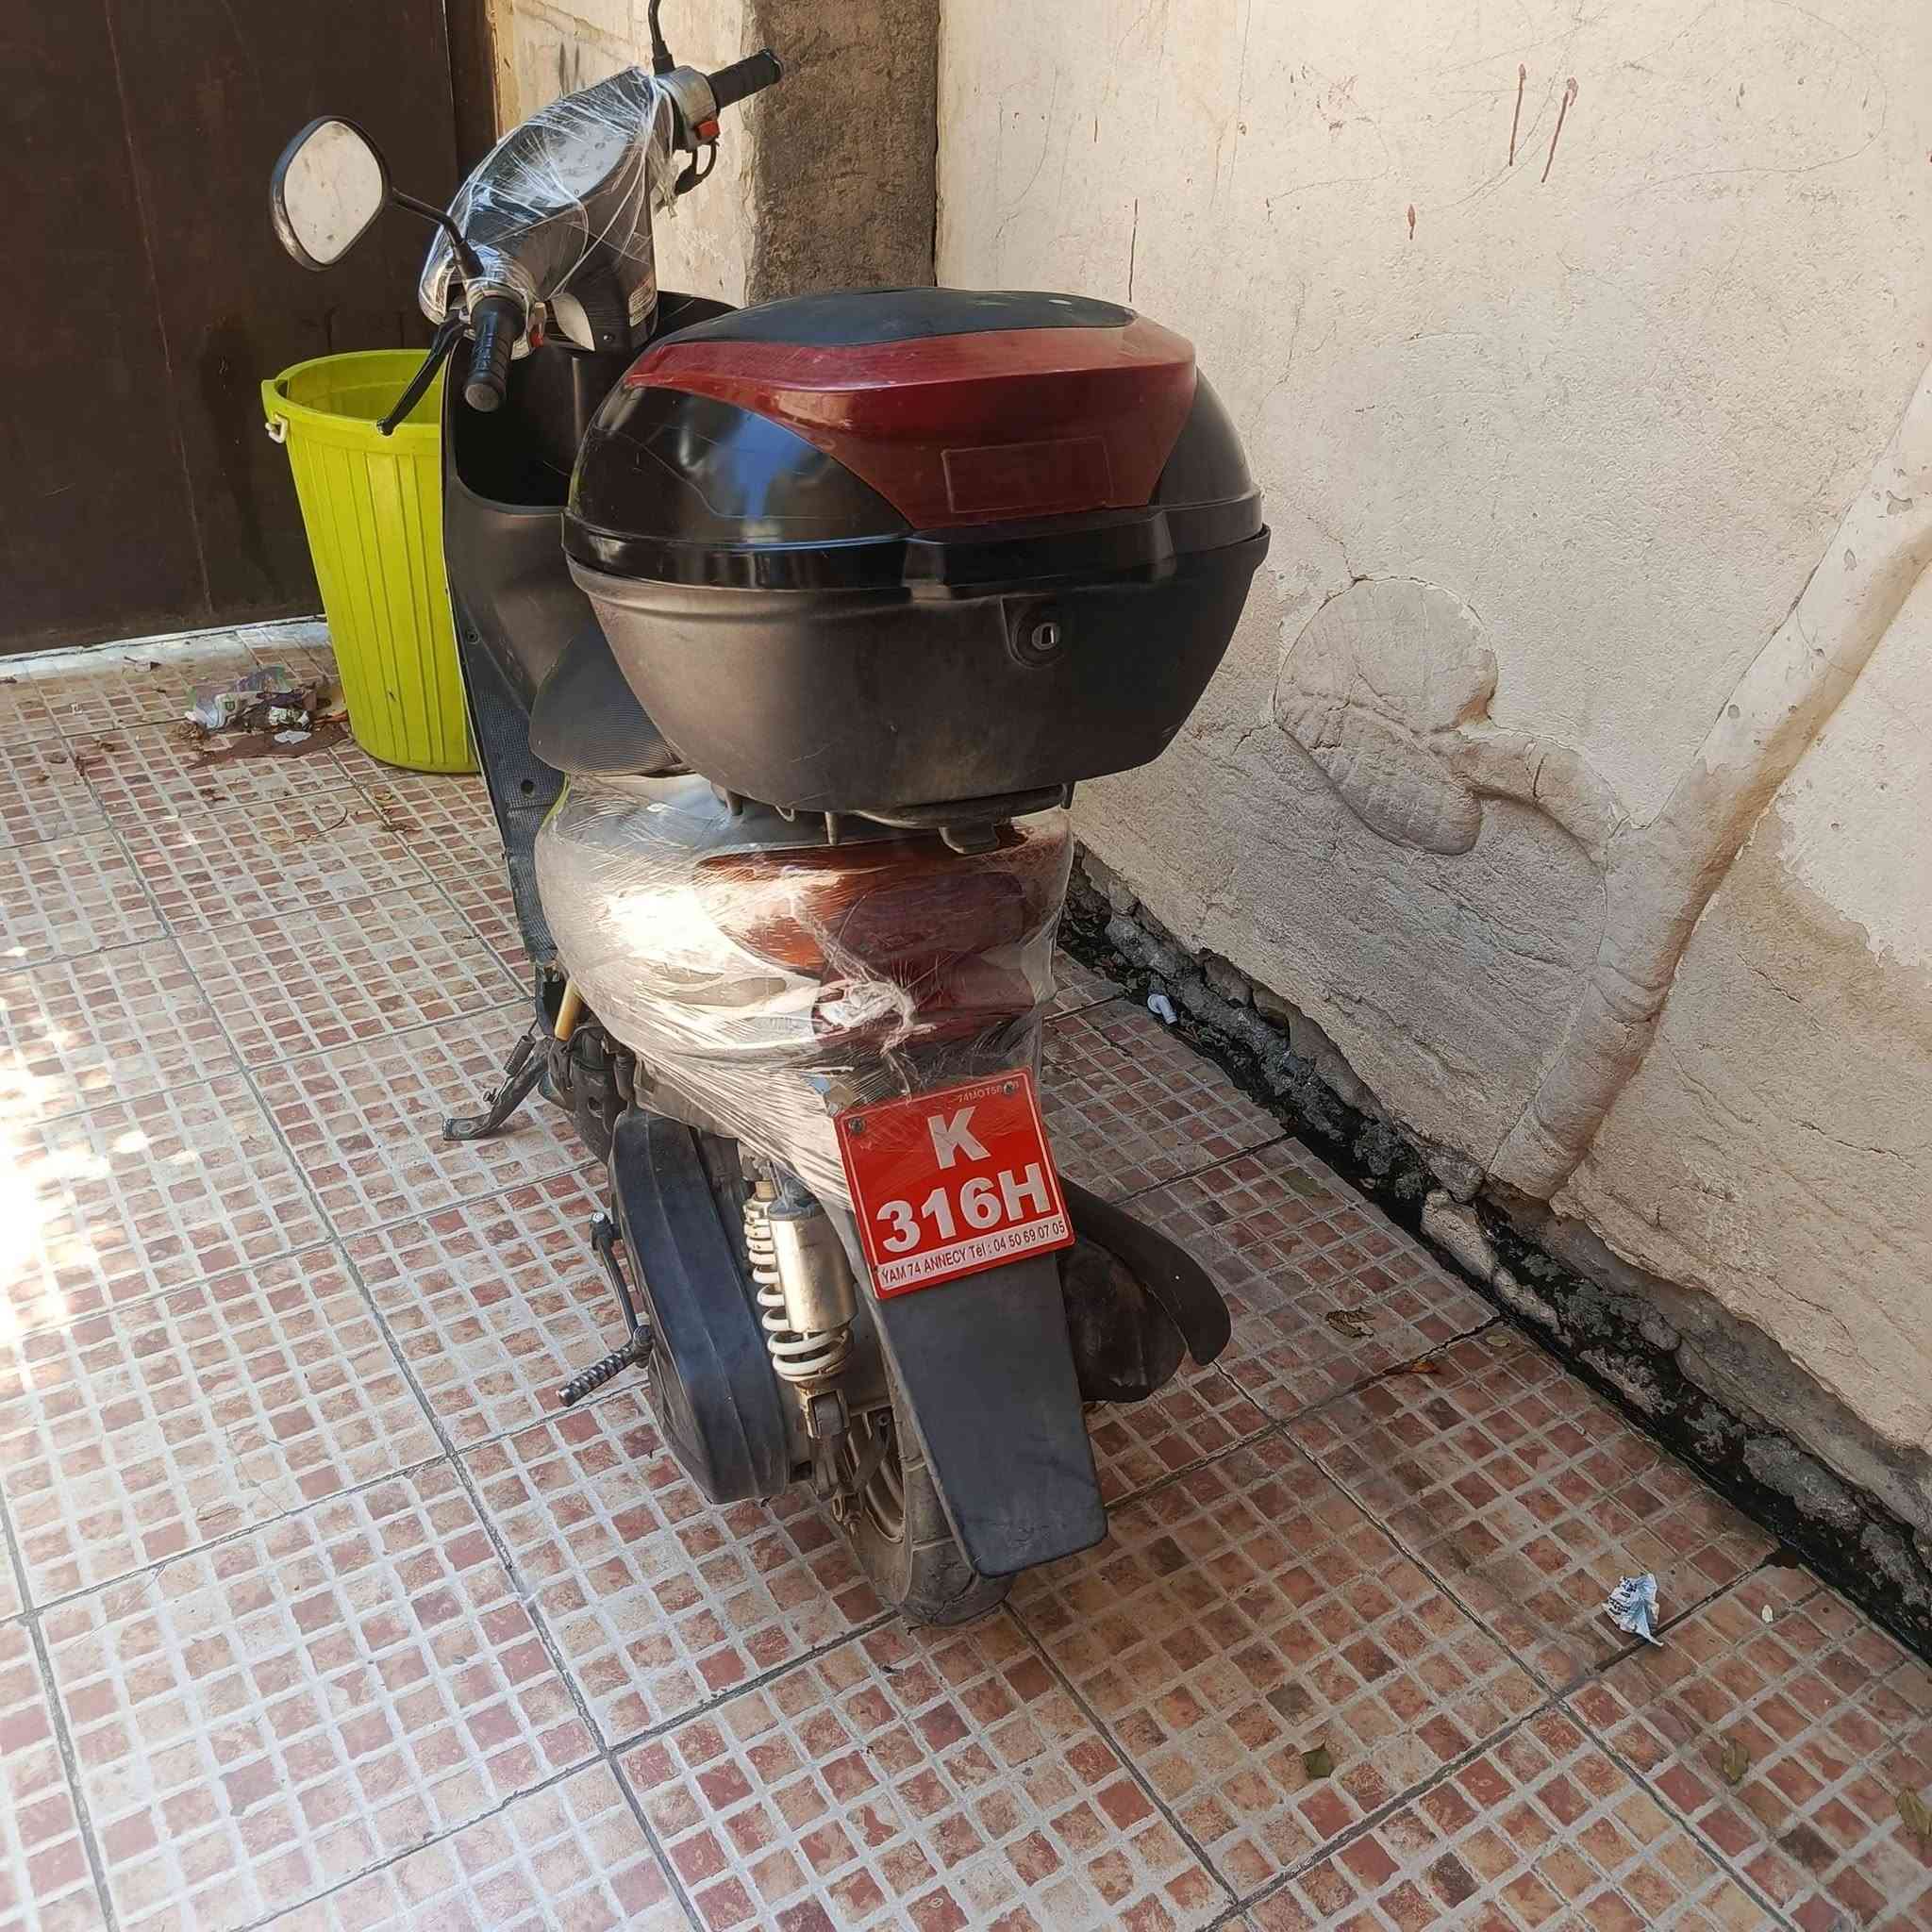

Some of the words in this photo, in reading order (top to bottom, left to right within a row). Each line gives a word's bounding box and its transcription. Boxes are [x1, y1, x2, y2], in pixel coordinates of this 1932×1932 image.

[927, 1106, 991, 1170] K
[876, 1162, 1050, 1253] 316H
[881, 1265, 907, 1284] YAM
[908, 1260, 922, 1277] 74
[924, 1250, 967, 1274] ANNECY
[969, 1241, 986, 1259] Tél
[994, 1236, 1008, 1253] 04
[1009, 1233, 1022, 1247] 50
[1024, 1229, 1036, 1243] 69
[1038, 1224, 1050, 1240] 07
[1052, 1221, 1065, 1235] 05
